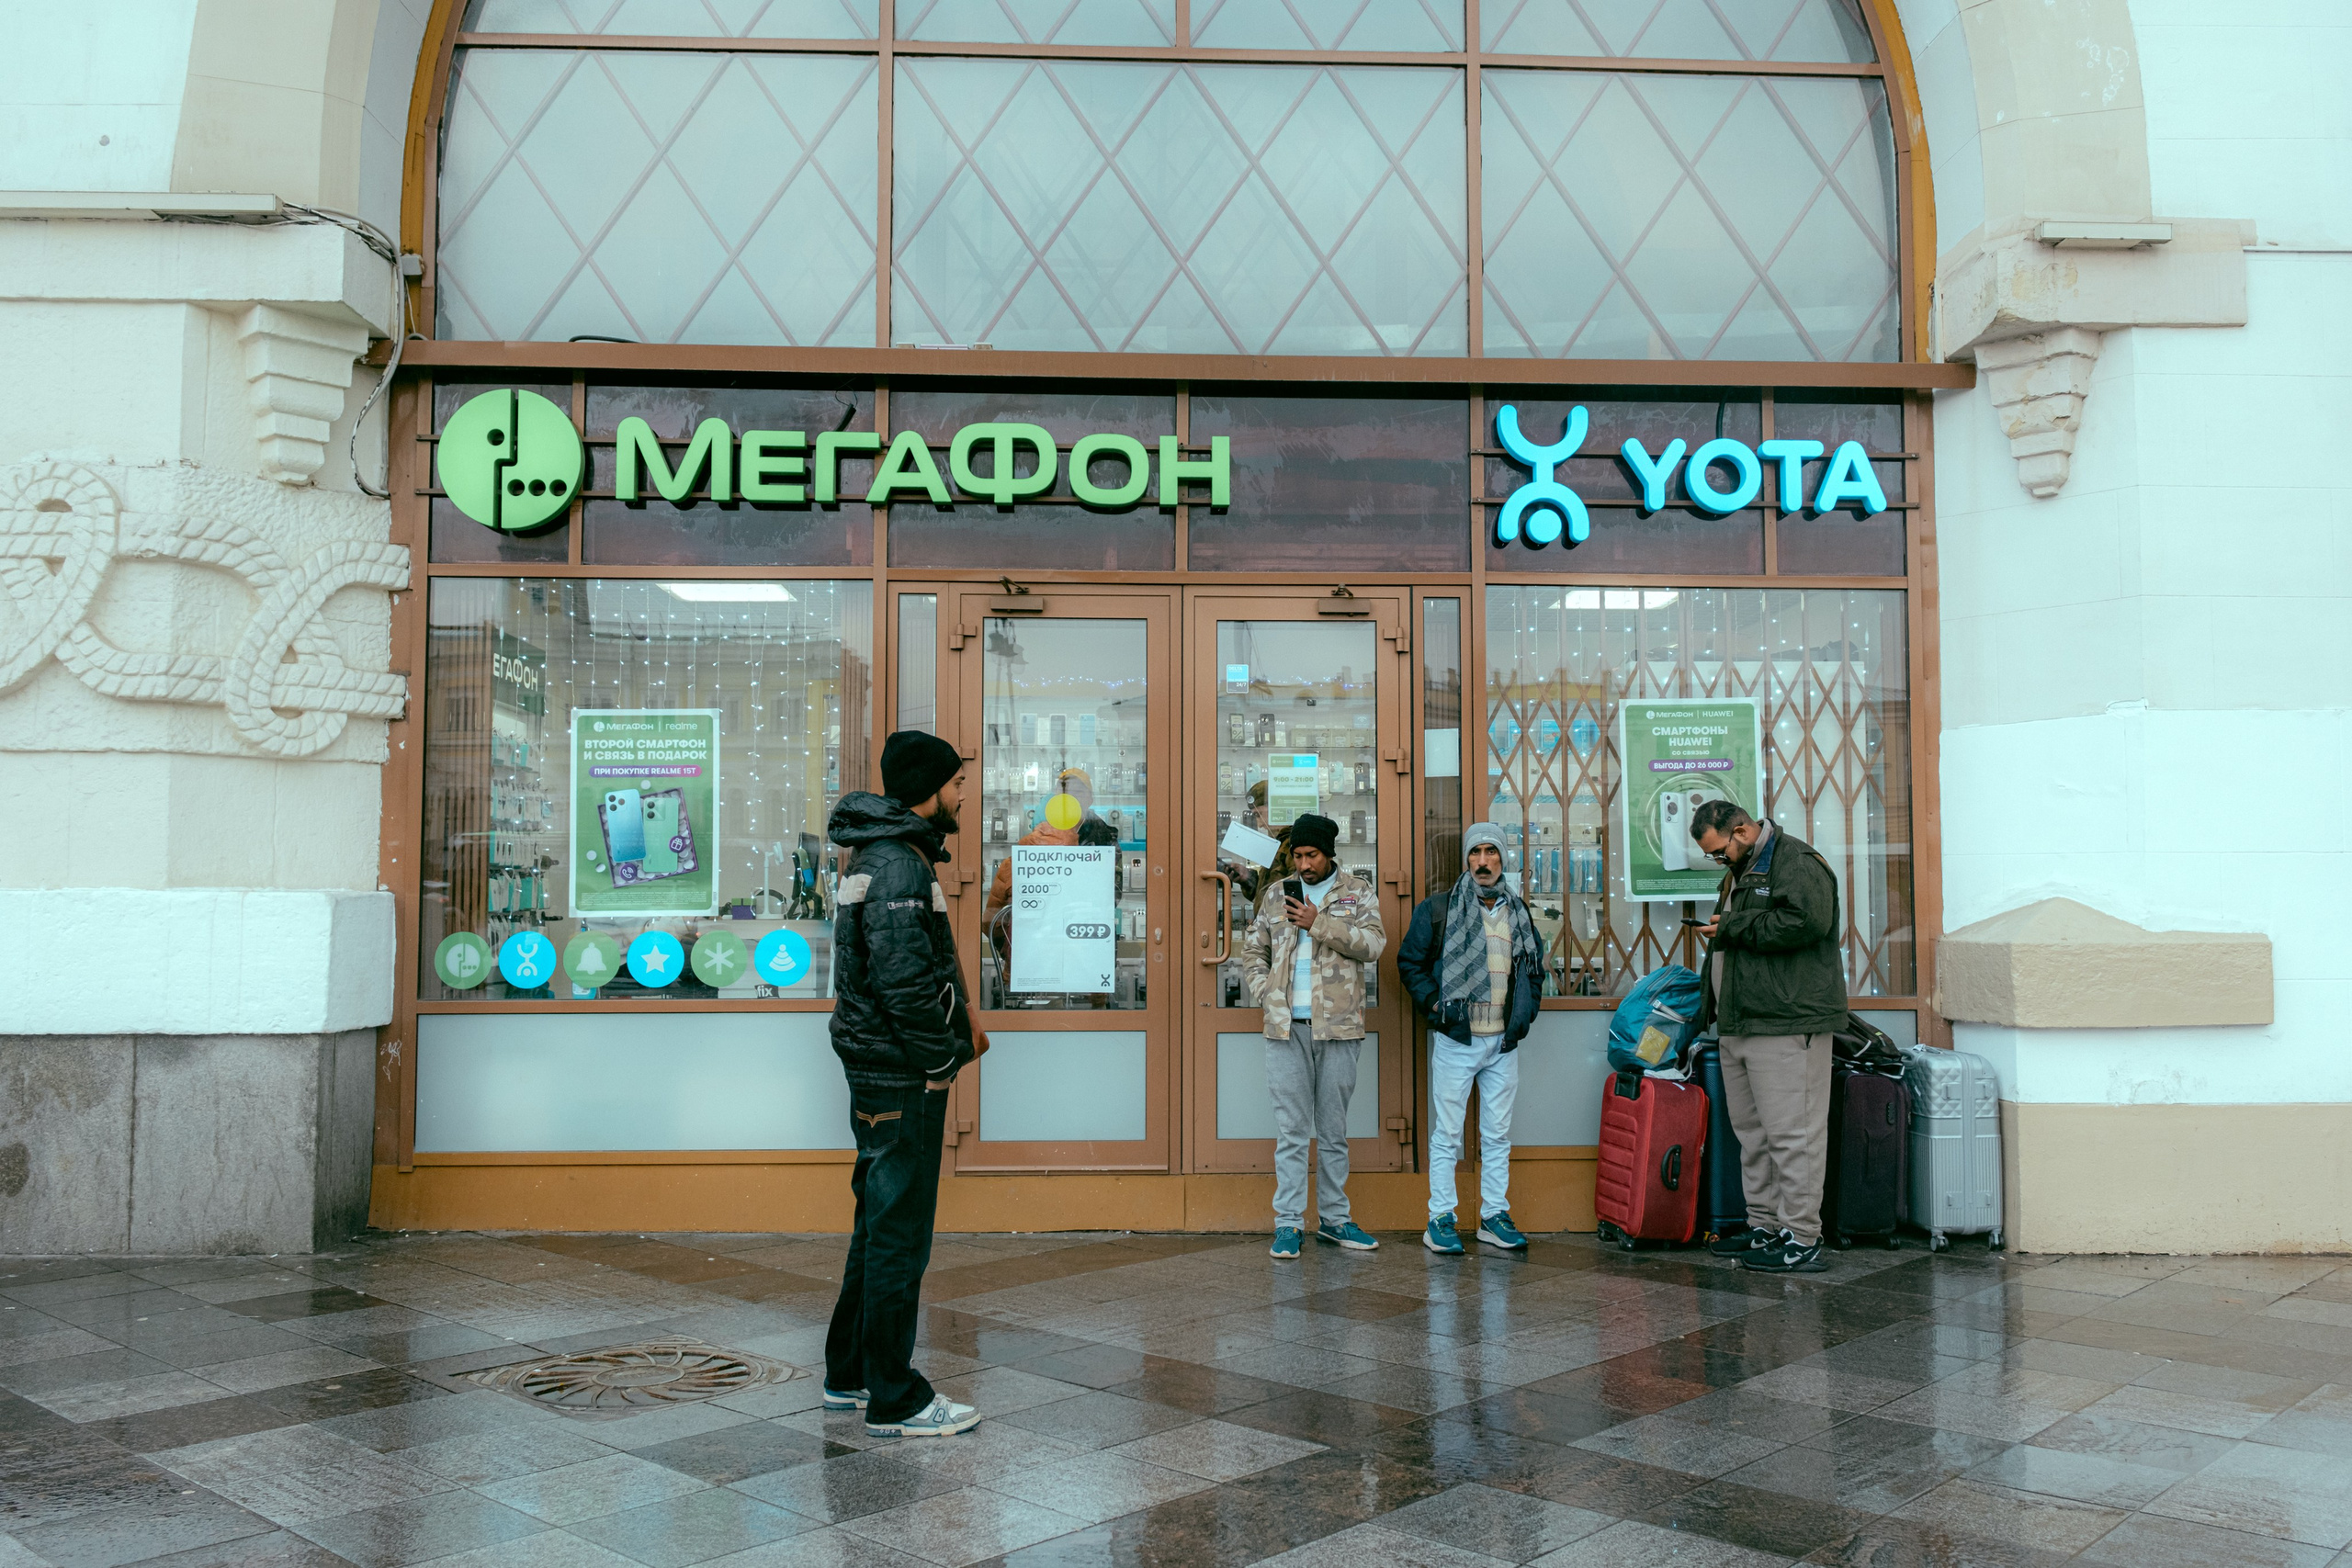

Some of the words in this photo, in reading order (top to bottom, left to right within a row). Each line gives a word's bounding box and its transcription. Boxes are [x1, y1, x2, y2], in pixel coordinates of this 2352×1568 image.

[615, 416, 1231, 508] МЕГАФОН
[1620, 437, 1888, 515] YOTA
[492, 652, 538, 693] ЕГАФОН
[665, 722, 698, 730] realme
[1652, 726, 1728, 736] СМАРТФОНЫ
[584, 738, 634, 749] ВТОРОЙ
[636, 739, 707, 749] СМАРТФОН
[1668, 738, 1713, 746] HUAWEI
[583, 750, 592, 761] И
[594, 750, 635, 761] СВЯЗЬ
[637, 750, 645, 760] В
[648, 750, 707, 761] ПОДАРОК
[613, 767, 650, 775] ПОКУПКЕ
[1017, 850, 1102, 863] Подключай
[1017, 865, 1073, 879] просто
[1021, 885, 1049, 894] 2000
[1069, 925, 1095, 937] 399
[757, 985, 774, 998] fix
